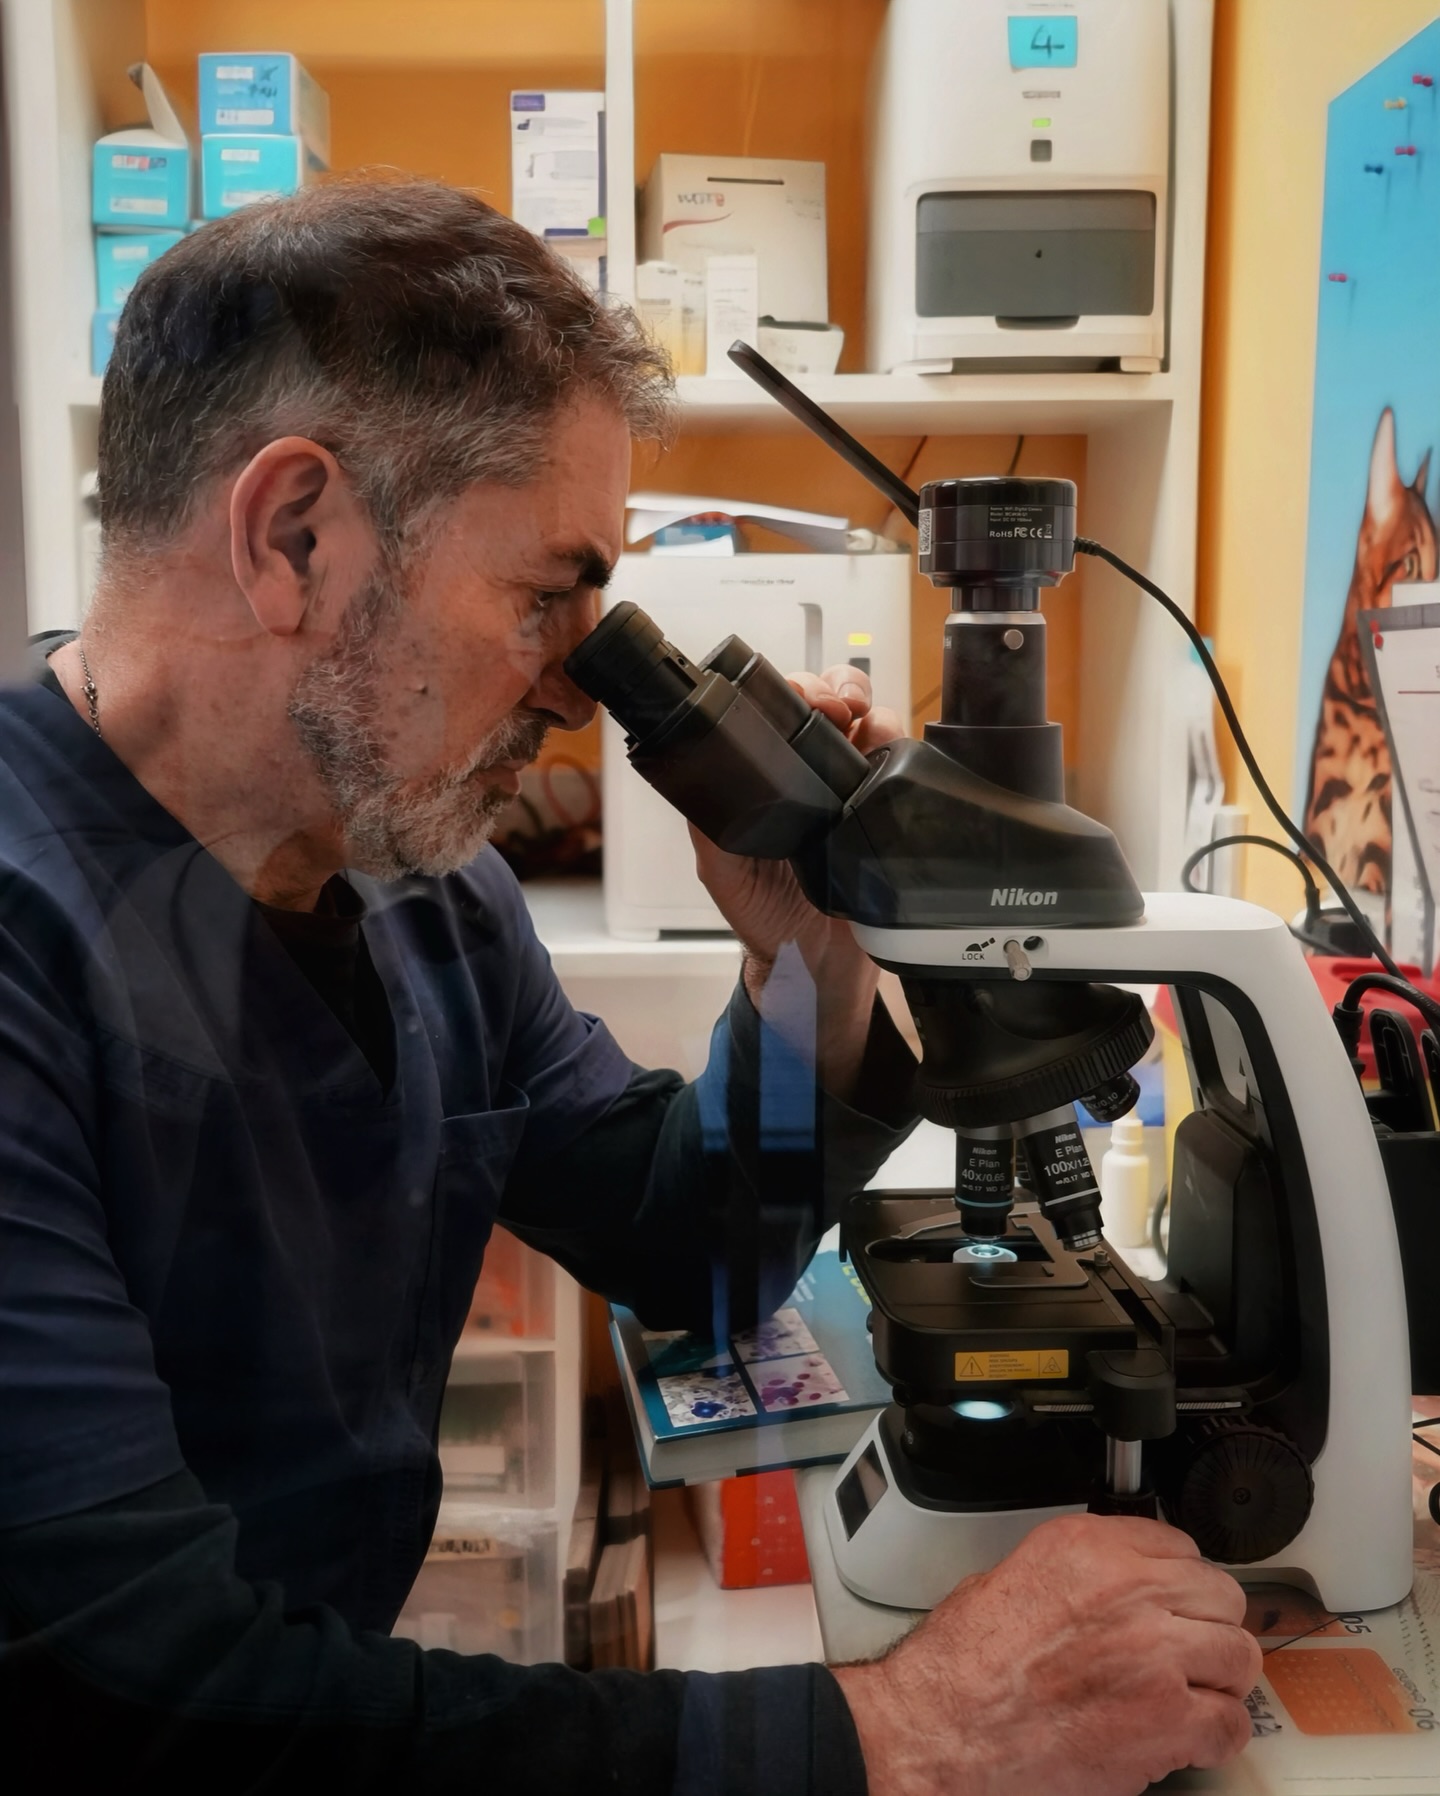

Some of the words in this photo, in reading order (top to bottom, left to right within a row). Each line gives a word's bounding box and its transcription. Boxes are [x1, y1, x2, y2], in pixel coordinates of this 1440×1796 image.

[1030, 25, 1065, 59] 4
[989, 530, 1013, 538] RoHS
[1029, 528, 1043, 538] CE
[990, 888, 1058, 906] Nikon
[1055, 1132, 1077, 1144] Nikon
[972, 1147, 997, 1155] Nikon
[1055, 1149, 1064, 1158] E
[1065, 1144, 1083, 1155] Plan
[969, 1158, 975, 1167] E
[979, 1160, 1000, 1168] Plan
[1340, 1615, 1371, 1634] 05
[1408, 1708, 1440, 1731] 06
